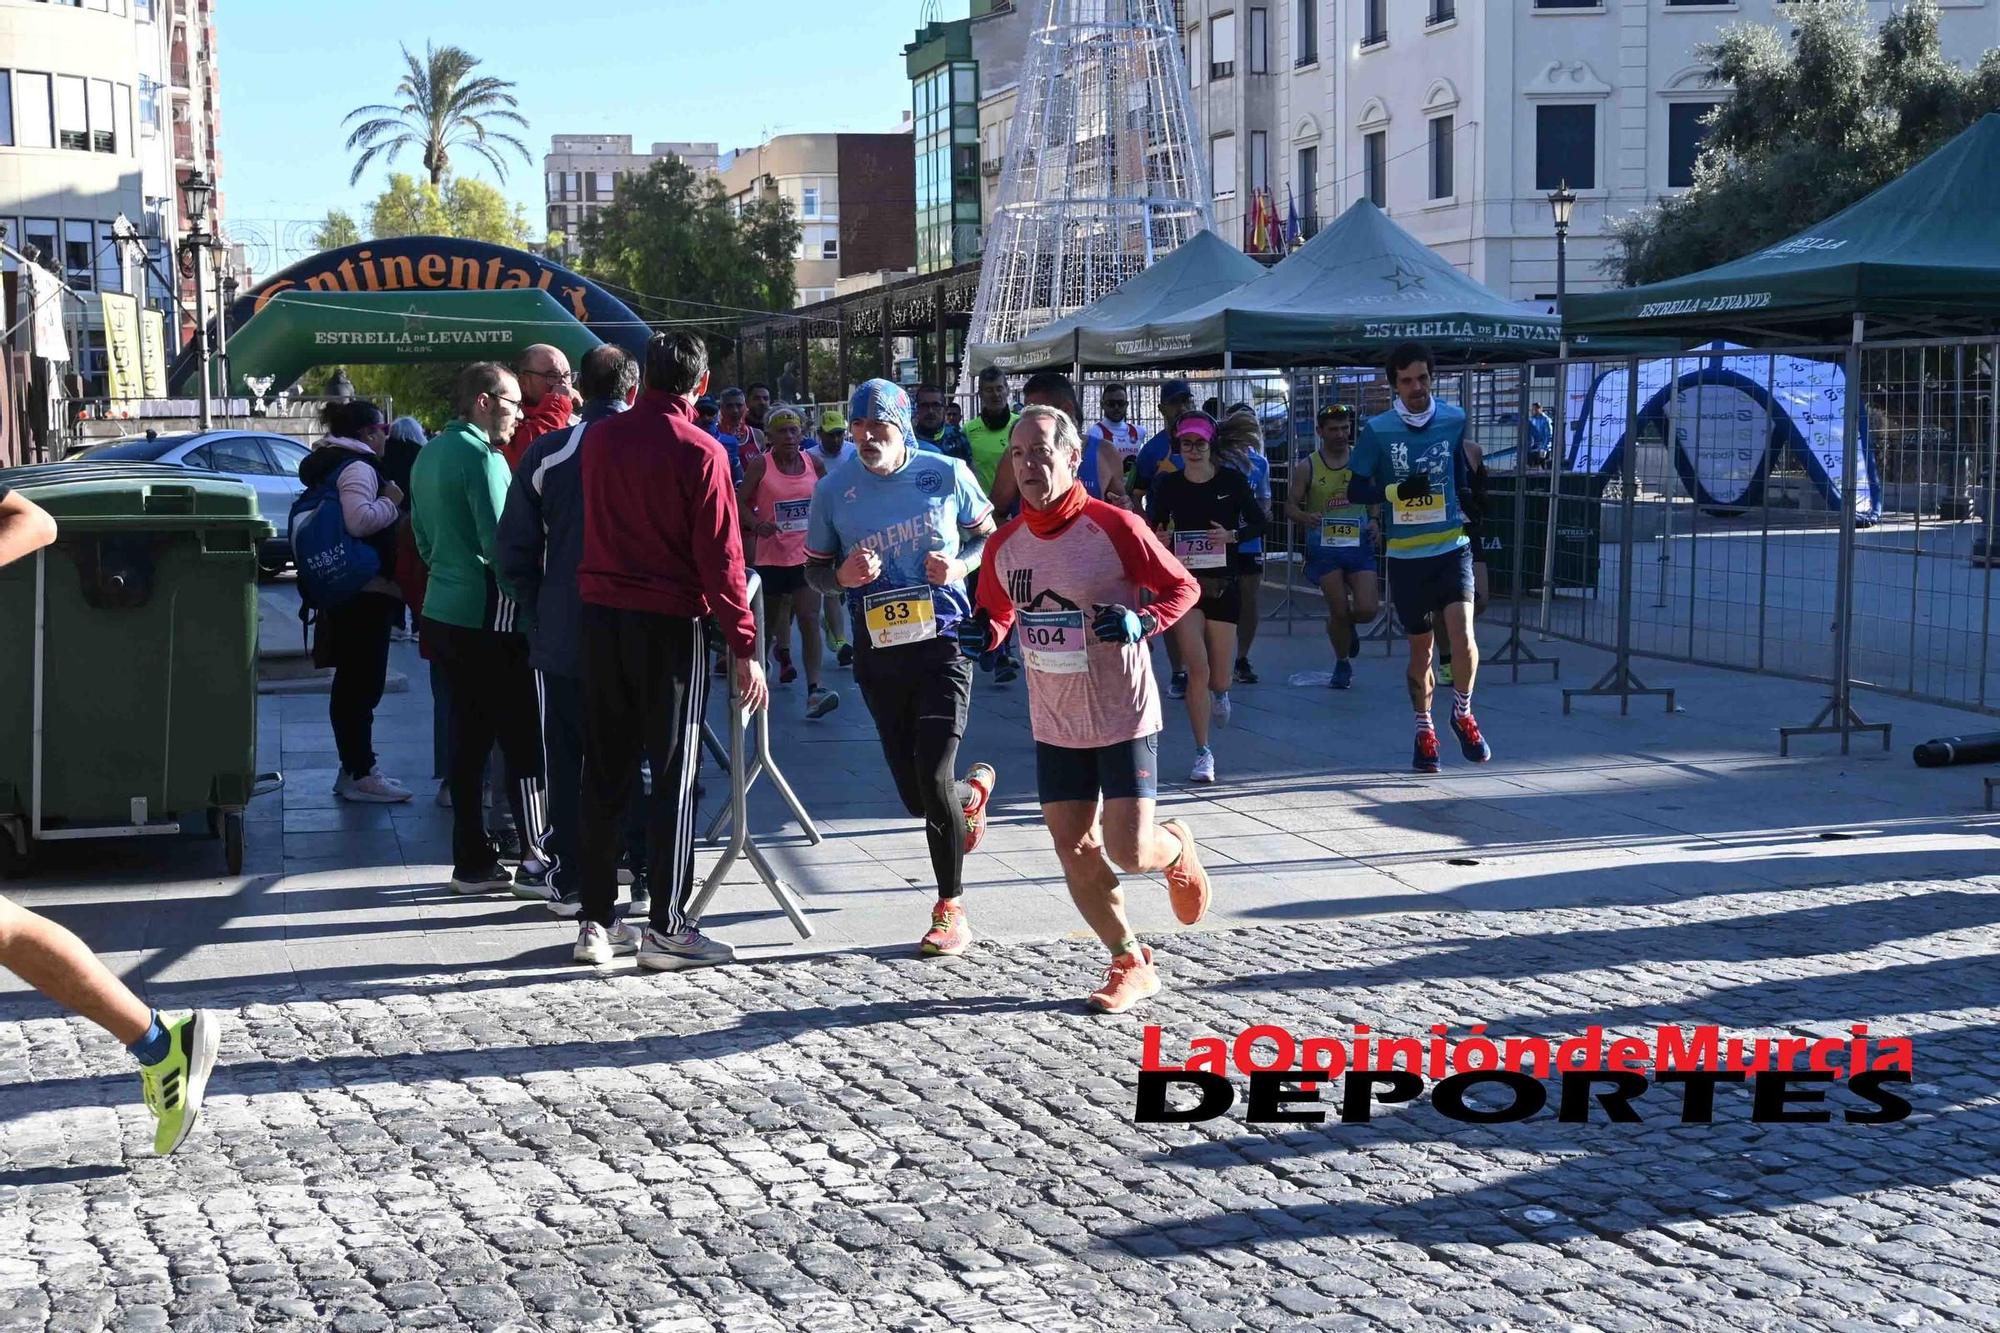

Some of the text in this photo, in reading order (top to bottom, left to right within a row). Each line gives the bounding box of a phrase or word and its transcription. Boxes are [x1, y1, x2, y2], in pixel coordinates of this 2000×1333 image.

[1638, 298, 1701, 318] ESTRELLA
[1707, 292, 1772, 311] LEVANTE
[315, 331, 412, 344] ESTRELLA
[427, 330, 513, 343] LEVANTE
[1364, 321, 1589, 343] ESTRELLA DE LEVANE
[1405, 495, 1434, 508] 230
[785, 507, 807, 518] 733
[1331, 526, 1352, 535] 143
[1187, 540, 1213, 552] 736
[1007, 568, 1033, 604] VIII
[884, 602, 910, 621] 83
[1027, 627, 1066, 646] 604
